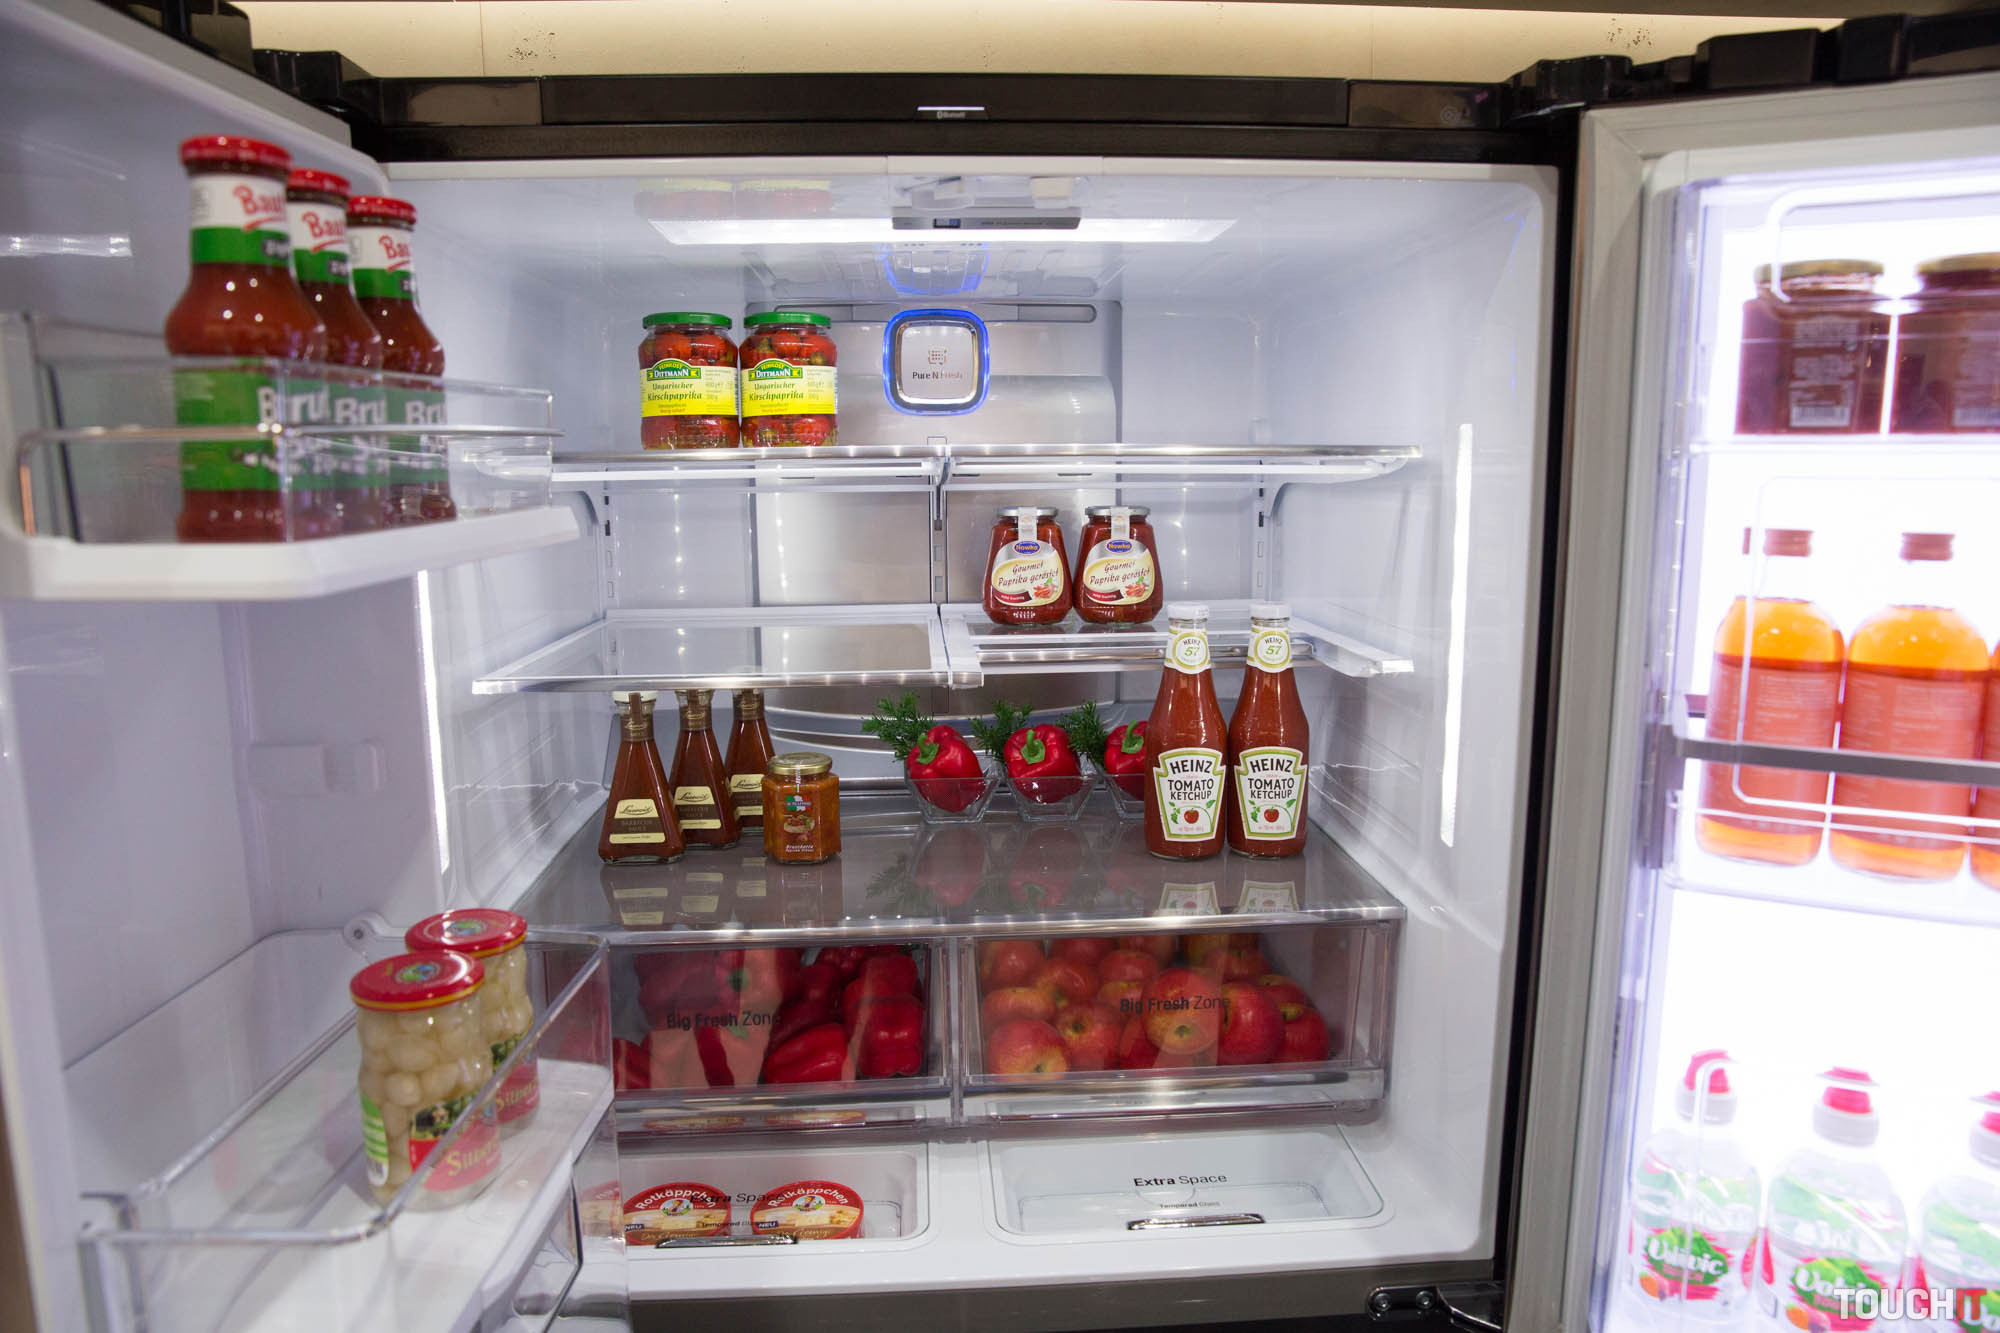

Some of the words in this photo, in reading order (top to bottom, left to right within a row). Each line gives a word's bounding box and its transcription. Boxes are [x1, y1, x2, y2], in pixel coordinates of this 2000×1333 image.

[912, 371, 931, 380] Pure
[932, 371, 939, 380] N
[1012, 560, 1044, 576] Gourmet
[1104, 559, 1136, 574] Gourmet
[998, 574, 1028, 587] Paprika
[1089, 573, 1120, 586] Paprika
[1183, 638, 1201, 646] HEINZ
[1183, 646, 1200, 657] 57
[1265, 645, 1283, 656] 57
[1169, 759, 1213, 775] HEINZ
[1249, 758, 1294, 774] HEINZ
[1167, 778, 1215, 792] TOMATO
[1247, 777, 1295, 791] TOMATO
[1170, 790, 1212, 801] KETCHUP
[1250, 789, 1293, 800] KETCHUP
[1119, 997, 1143, 1015] Big
[1147, 997, 1189, 1011] Fresh
[1193, 994, 1230, 1010] Zone
[666, 1012, 691, 1032] Big
[694, 1012, 738, 1028] Fresh
[1133, 1177, 1176, 1188] Extra
[1178, 1174, 1228, 1186] Space
[635, 1188, 717, 1210] Rotkäppchen
[767, 1187, 849, 1207] Rotkäppchen
[624, 1223, 644, 1231] NEU
[757, 1220, 777, 1229] NEU
